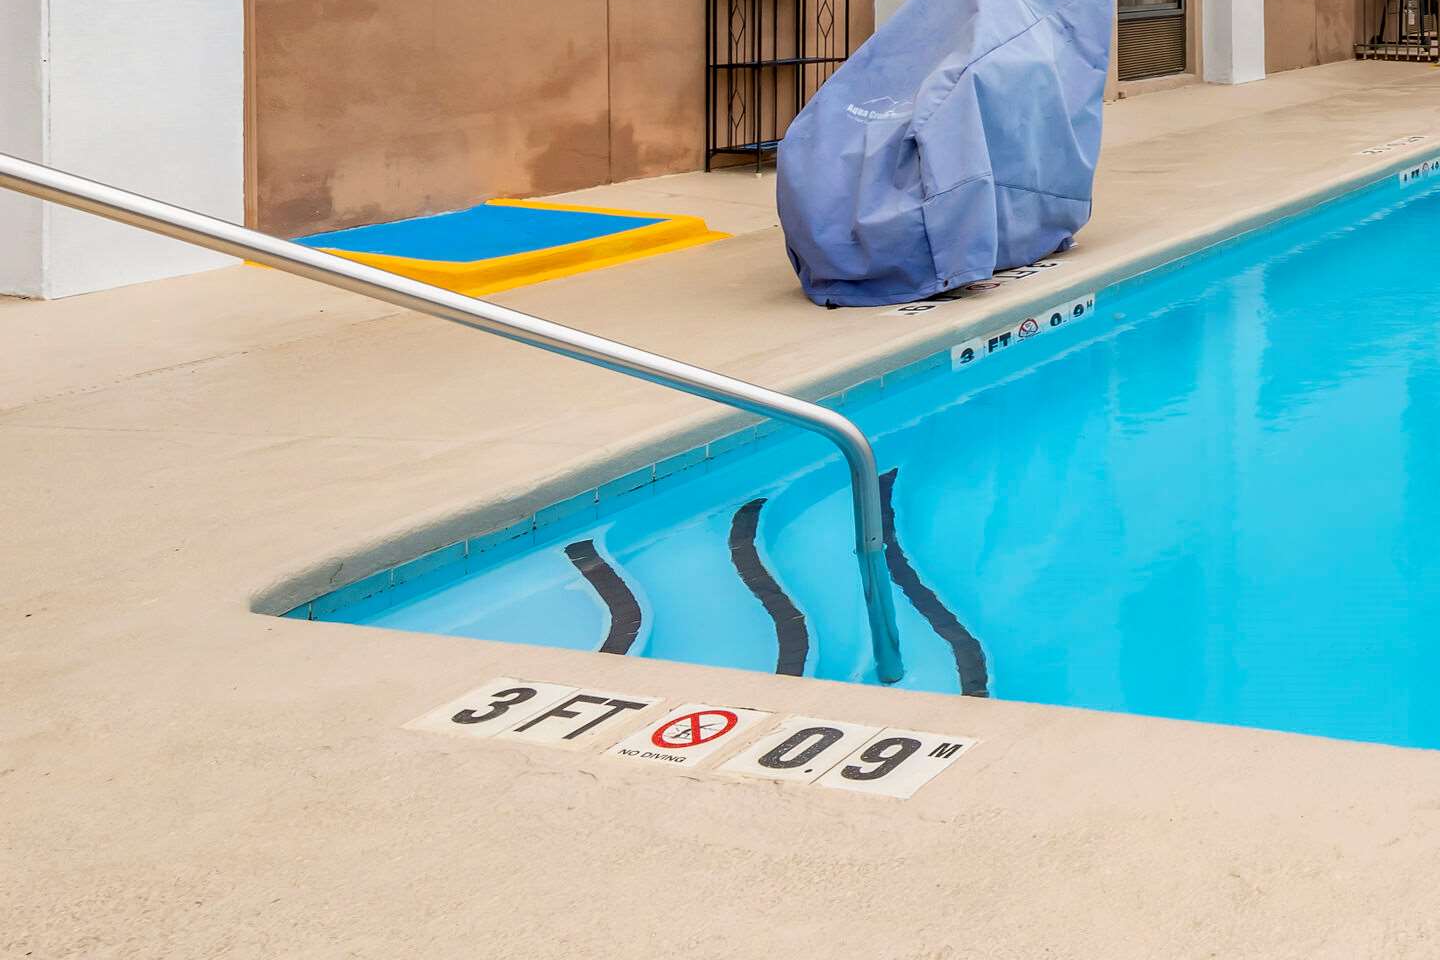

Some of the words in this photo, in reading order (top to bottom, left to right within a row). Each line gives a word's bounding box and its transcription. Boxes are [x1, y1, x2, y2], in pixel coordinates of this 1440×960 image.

[960, 347, 975, 364] 3
[988, 332, 1012, 353] FT
[450, 687, 538, 725] 3
[513, 694, 649, 740] FT
[756, 725, 924, 782] 0.9
[928, 742, 964, 760] M
[617, 748, 640, 756] NO
[640, 751, 687, 763] DIVING
